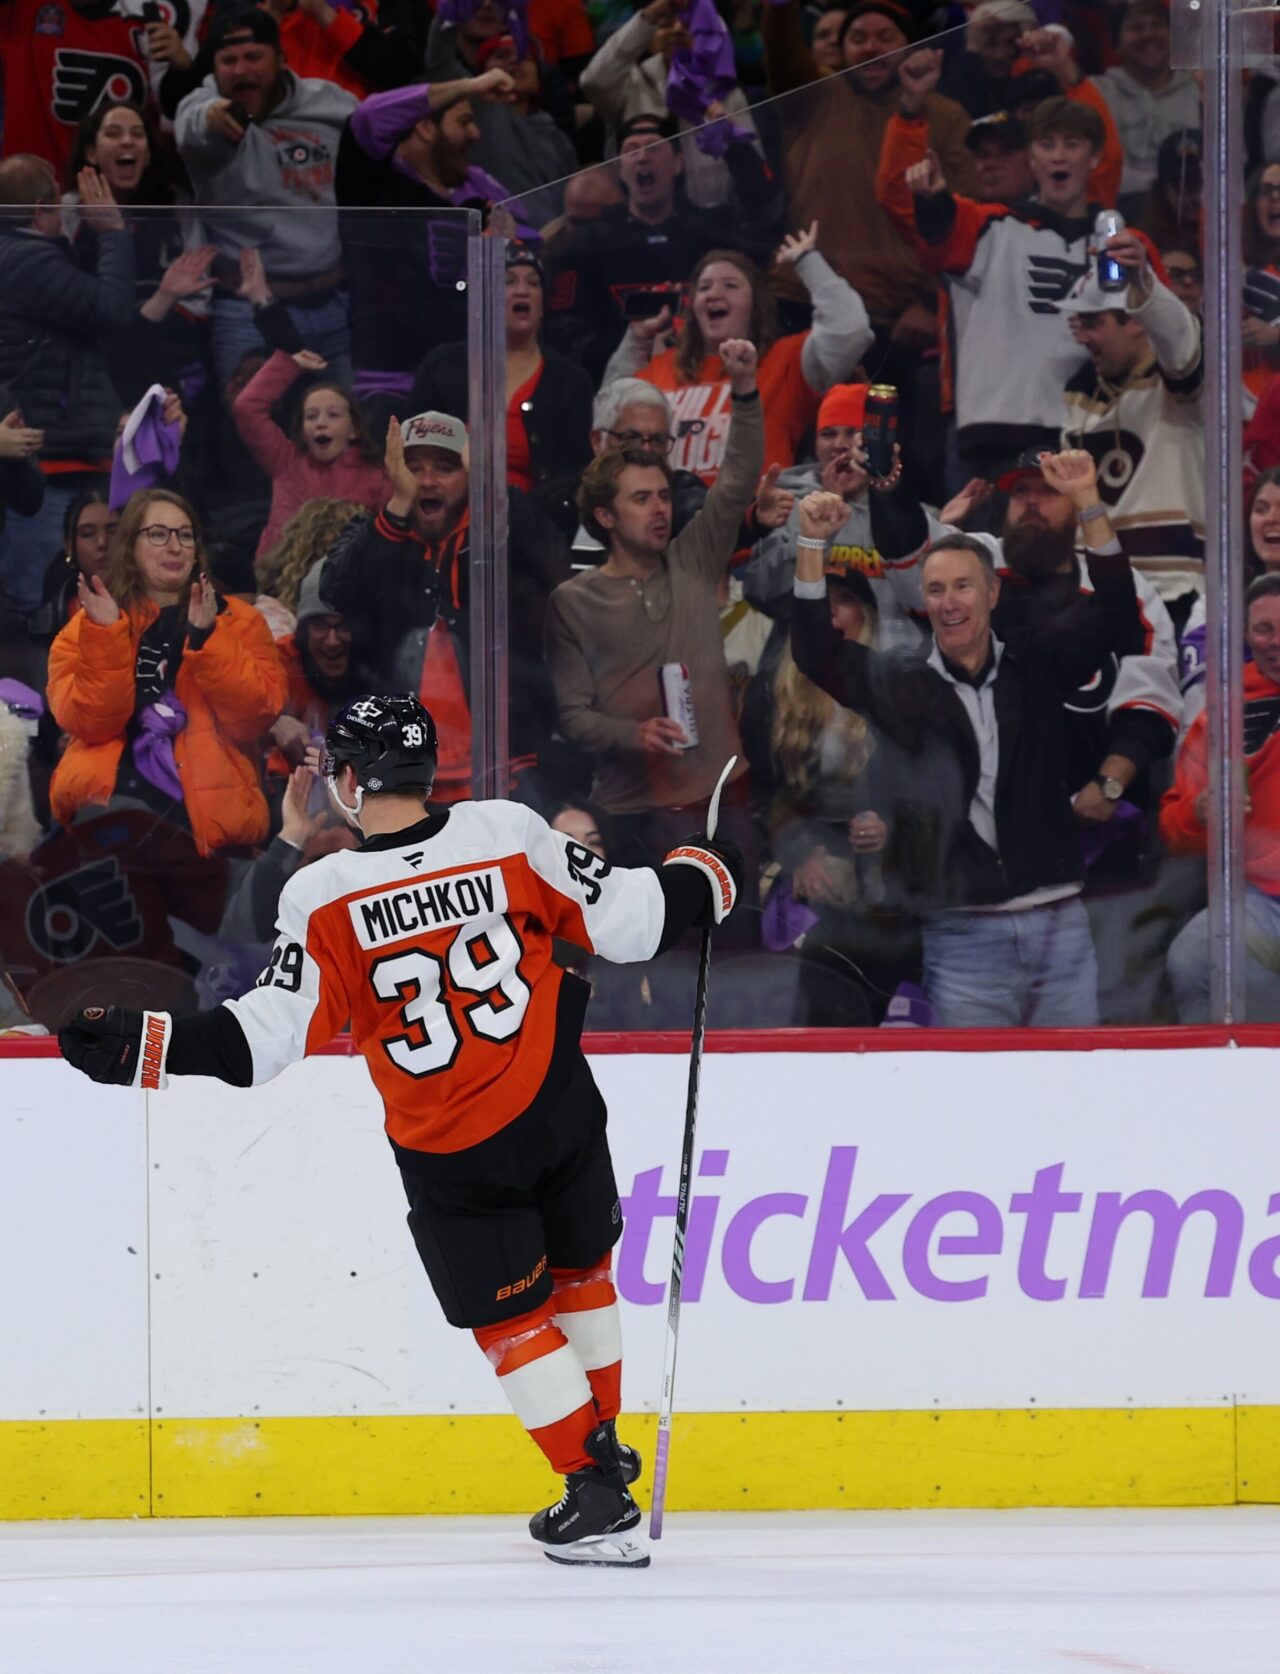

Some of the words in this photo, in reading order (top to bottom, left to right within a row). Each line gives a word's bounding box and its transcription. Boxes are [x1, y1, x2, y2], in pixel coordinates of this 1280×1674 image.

[406, 416, 455, 441] Flyers
[346, 714, 375, 729] CHEVROLET
[401, 723, 423, 748] 39
[360, 873, 492, 943] MICHKOV
[369, 911, 532, 1080] 39
